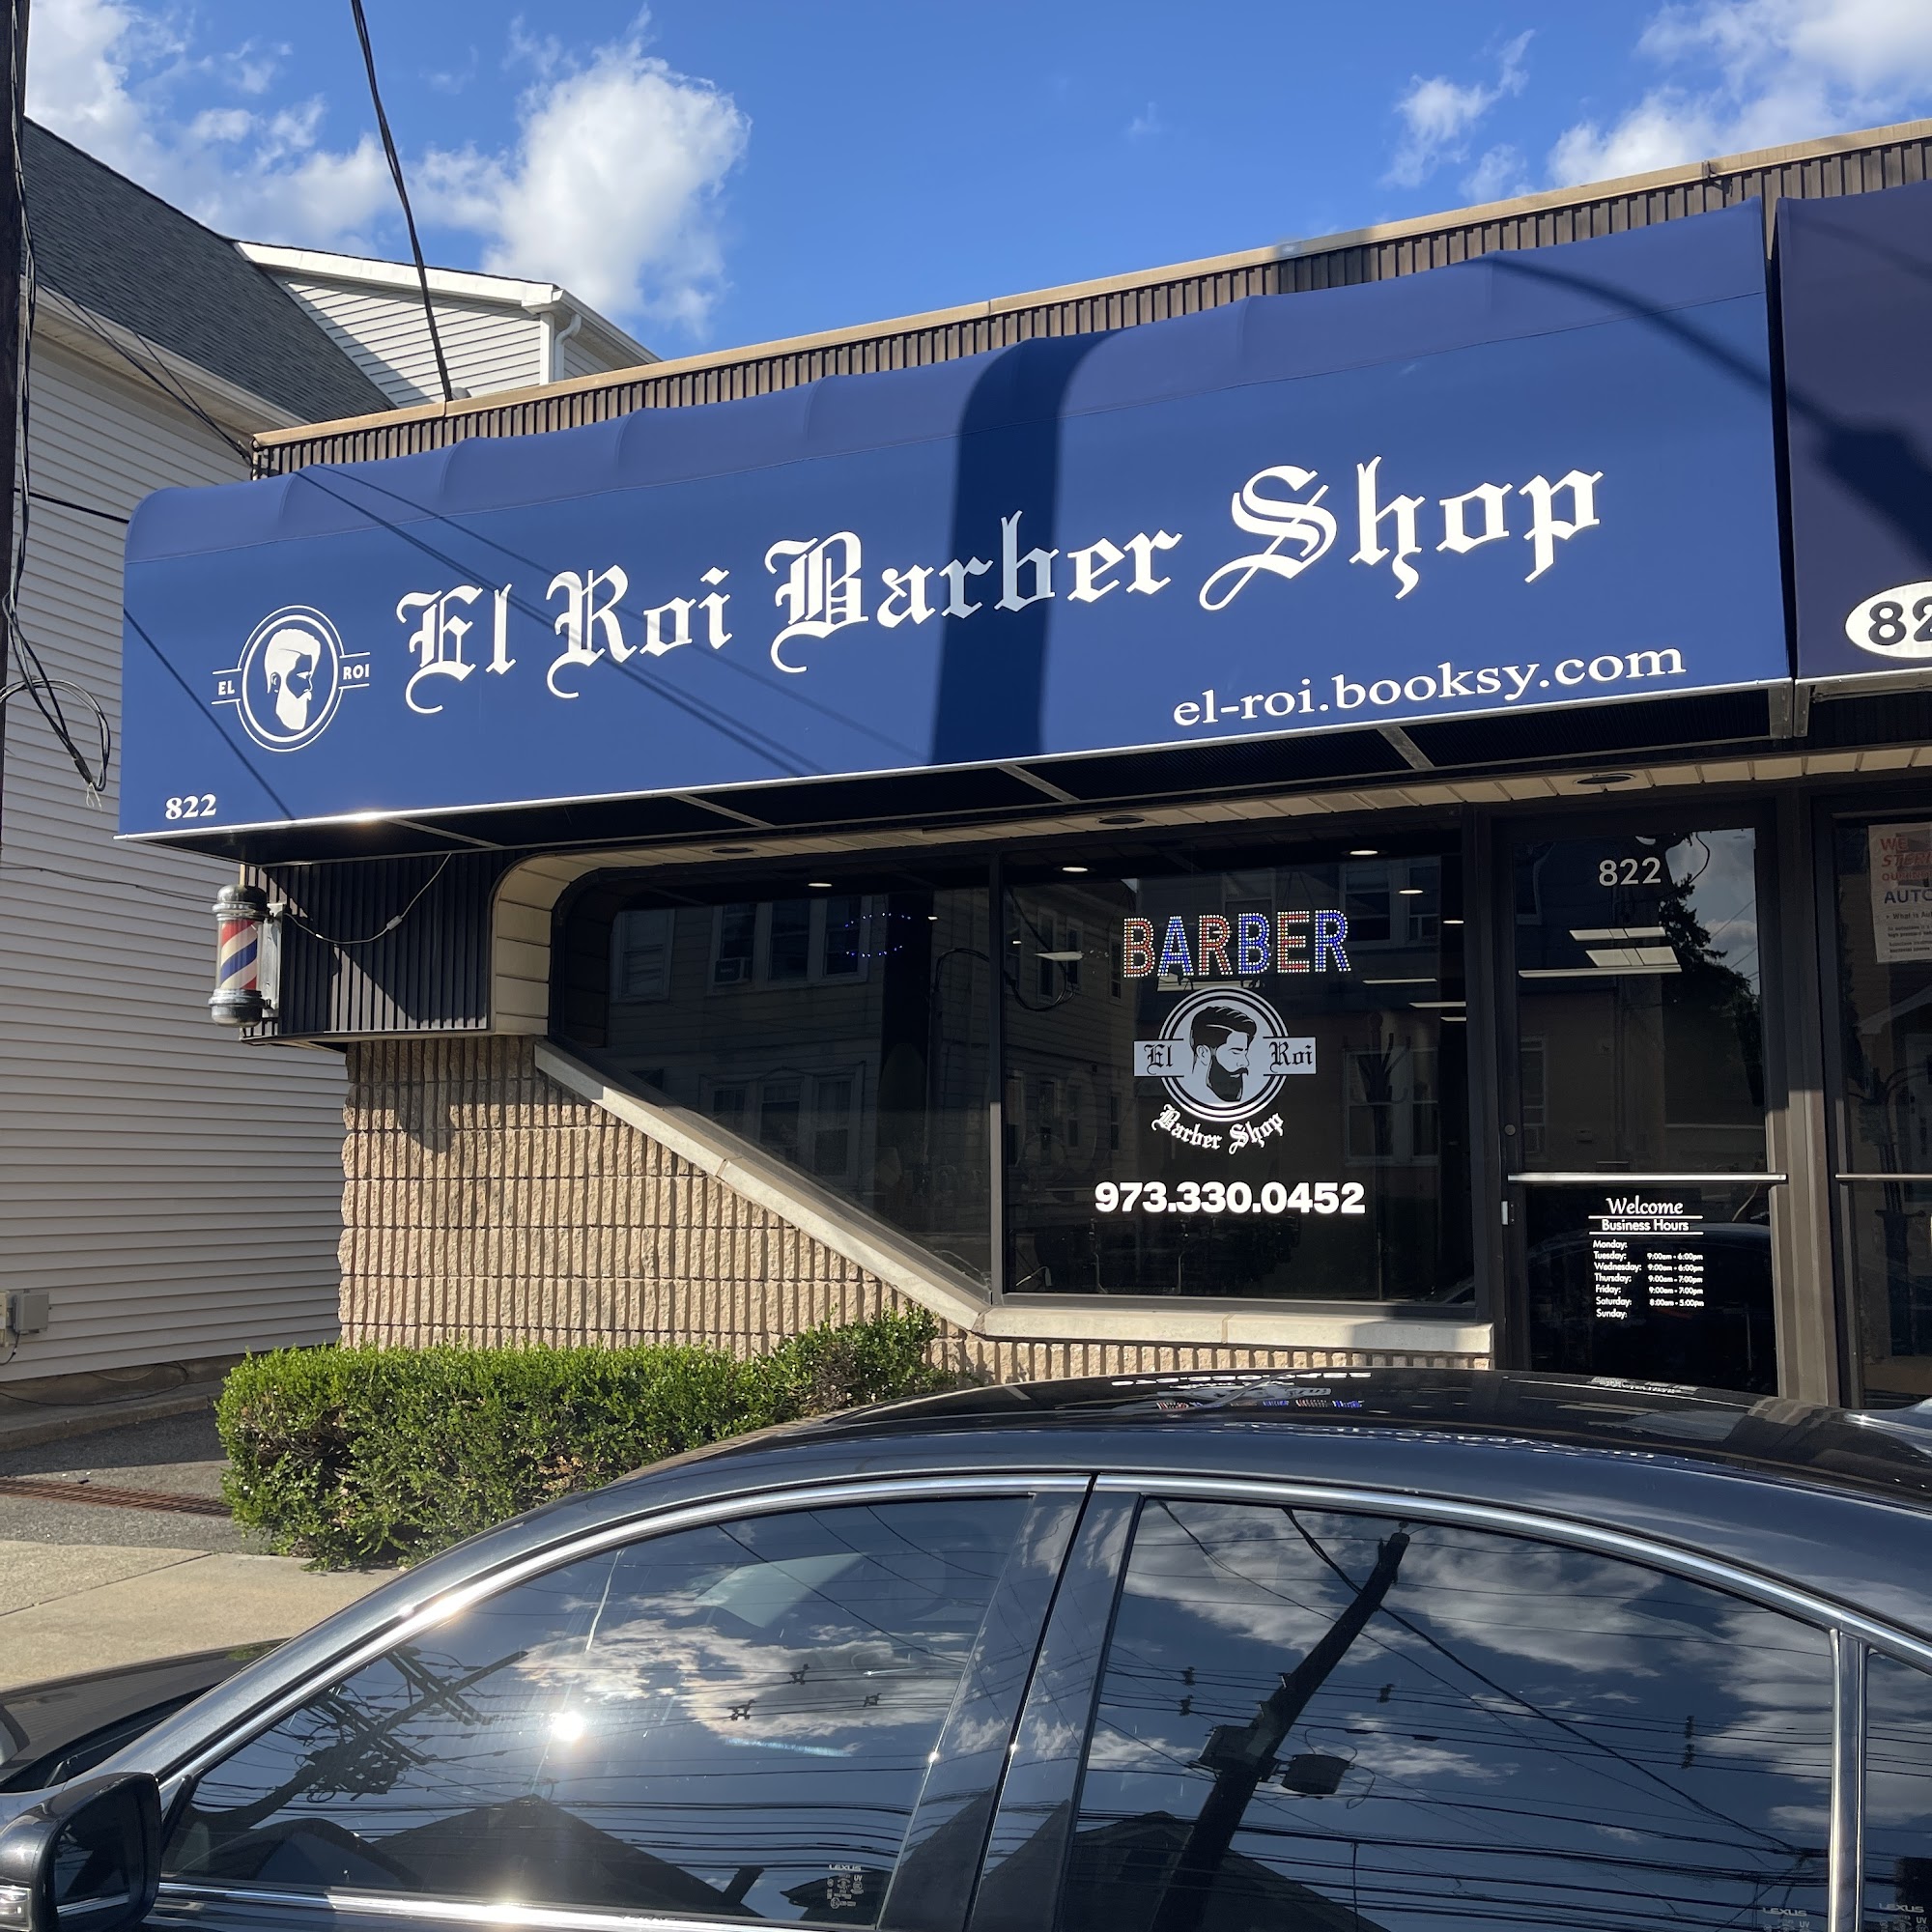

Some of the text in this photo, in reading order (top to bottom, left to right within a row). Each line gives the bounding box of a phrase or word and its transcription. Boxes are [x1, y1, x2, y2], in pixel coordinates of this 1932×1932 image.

[396, 455, 1604, 714] El Roi Barber Shop
[217, 664, 370, 696] EL ROI
[1173, 645, 1687, 726] el-roi.booksy.com
[165, 793, 216, 820] 822
[1880, 838, 1907, 850] WE
[1599, 856, 1662, 887] 822
[1123, 909, 1351, 978] BARBER
[1144, 1041, 1314, 1075] El Roi
[1151, 1103, 1285, 1154] Barber Shop
[1094, 1181, 1366, 1214] 973.330.0452
[1605, 1195, 1684, 1214] Welcome
[1602, 1219, 1690, 1231] Business Hours
[1592, 1239, 1628, 1250] Monday:
[1593, 1250, 1627, 1262] Tuesday:
[1677, 1253, 1703, 1262] 6:00pm
[1594, 1262, 1642, 1273] Wednesday:
[1678, 1264, 1704, 1273] 6:00pm
[1594, 1272, 1632, 1284] Thursday:
[1678, 1275, 1703, 1284] 7:00pm
[1596, 1284, 1621, 1295] Friday:
[1679, 1287, 1703, 1295] 7:00pm
[1596, 1296, 1632, 1308] Saturday:
[1597, 1308, 1627, 1320] Sunday:
[1763, 1907, 1807, 1917] LEXUS
[1879, 1902, 1924, 1913] LEXUS
